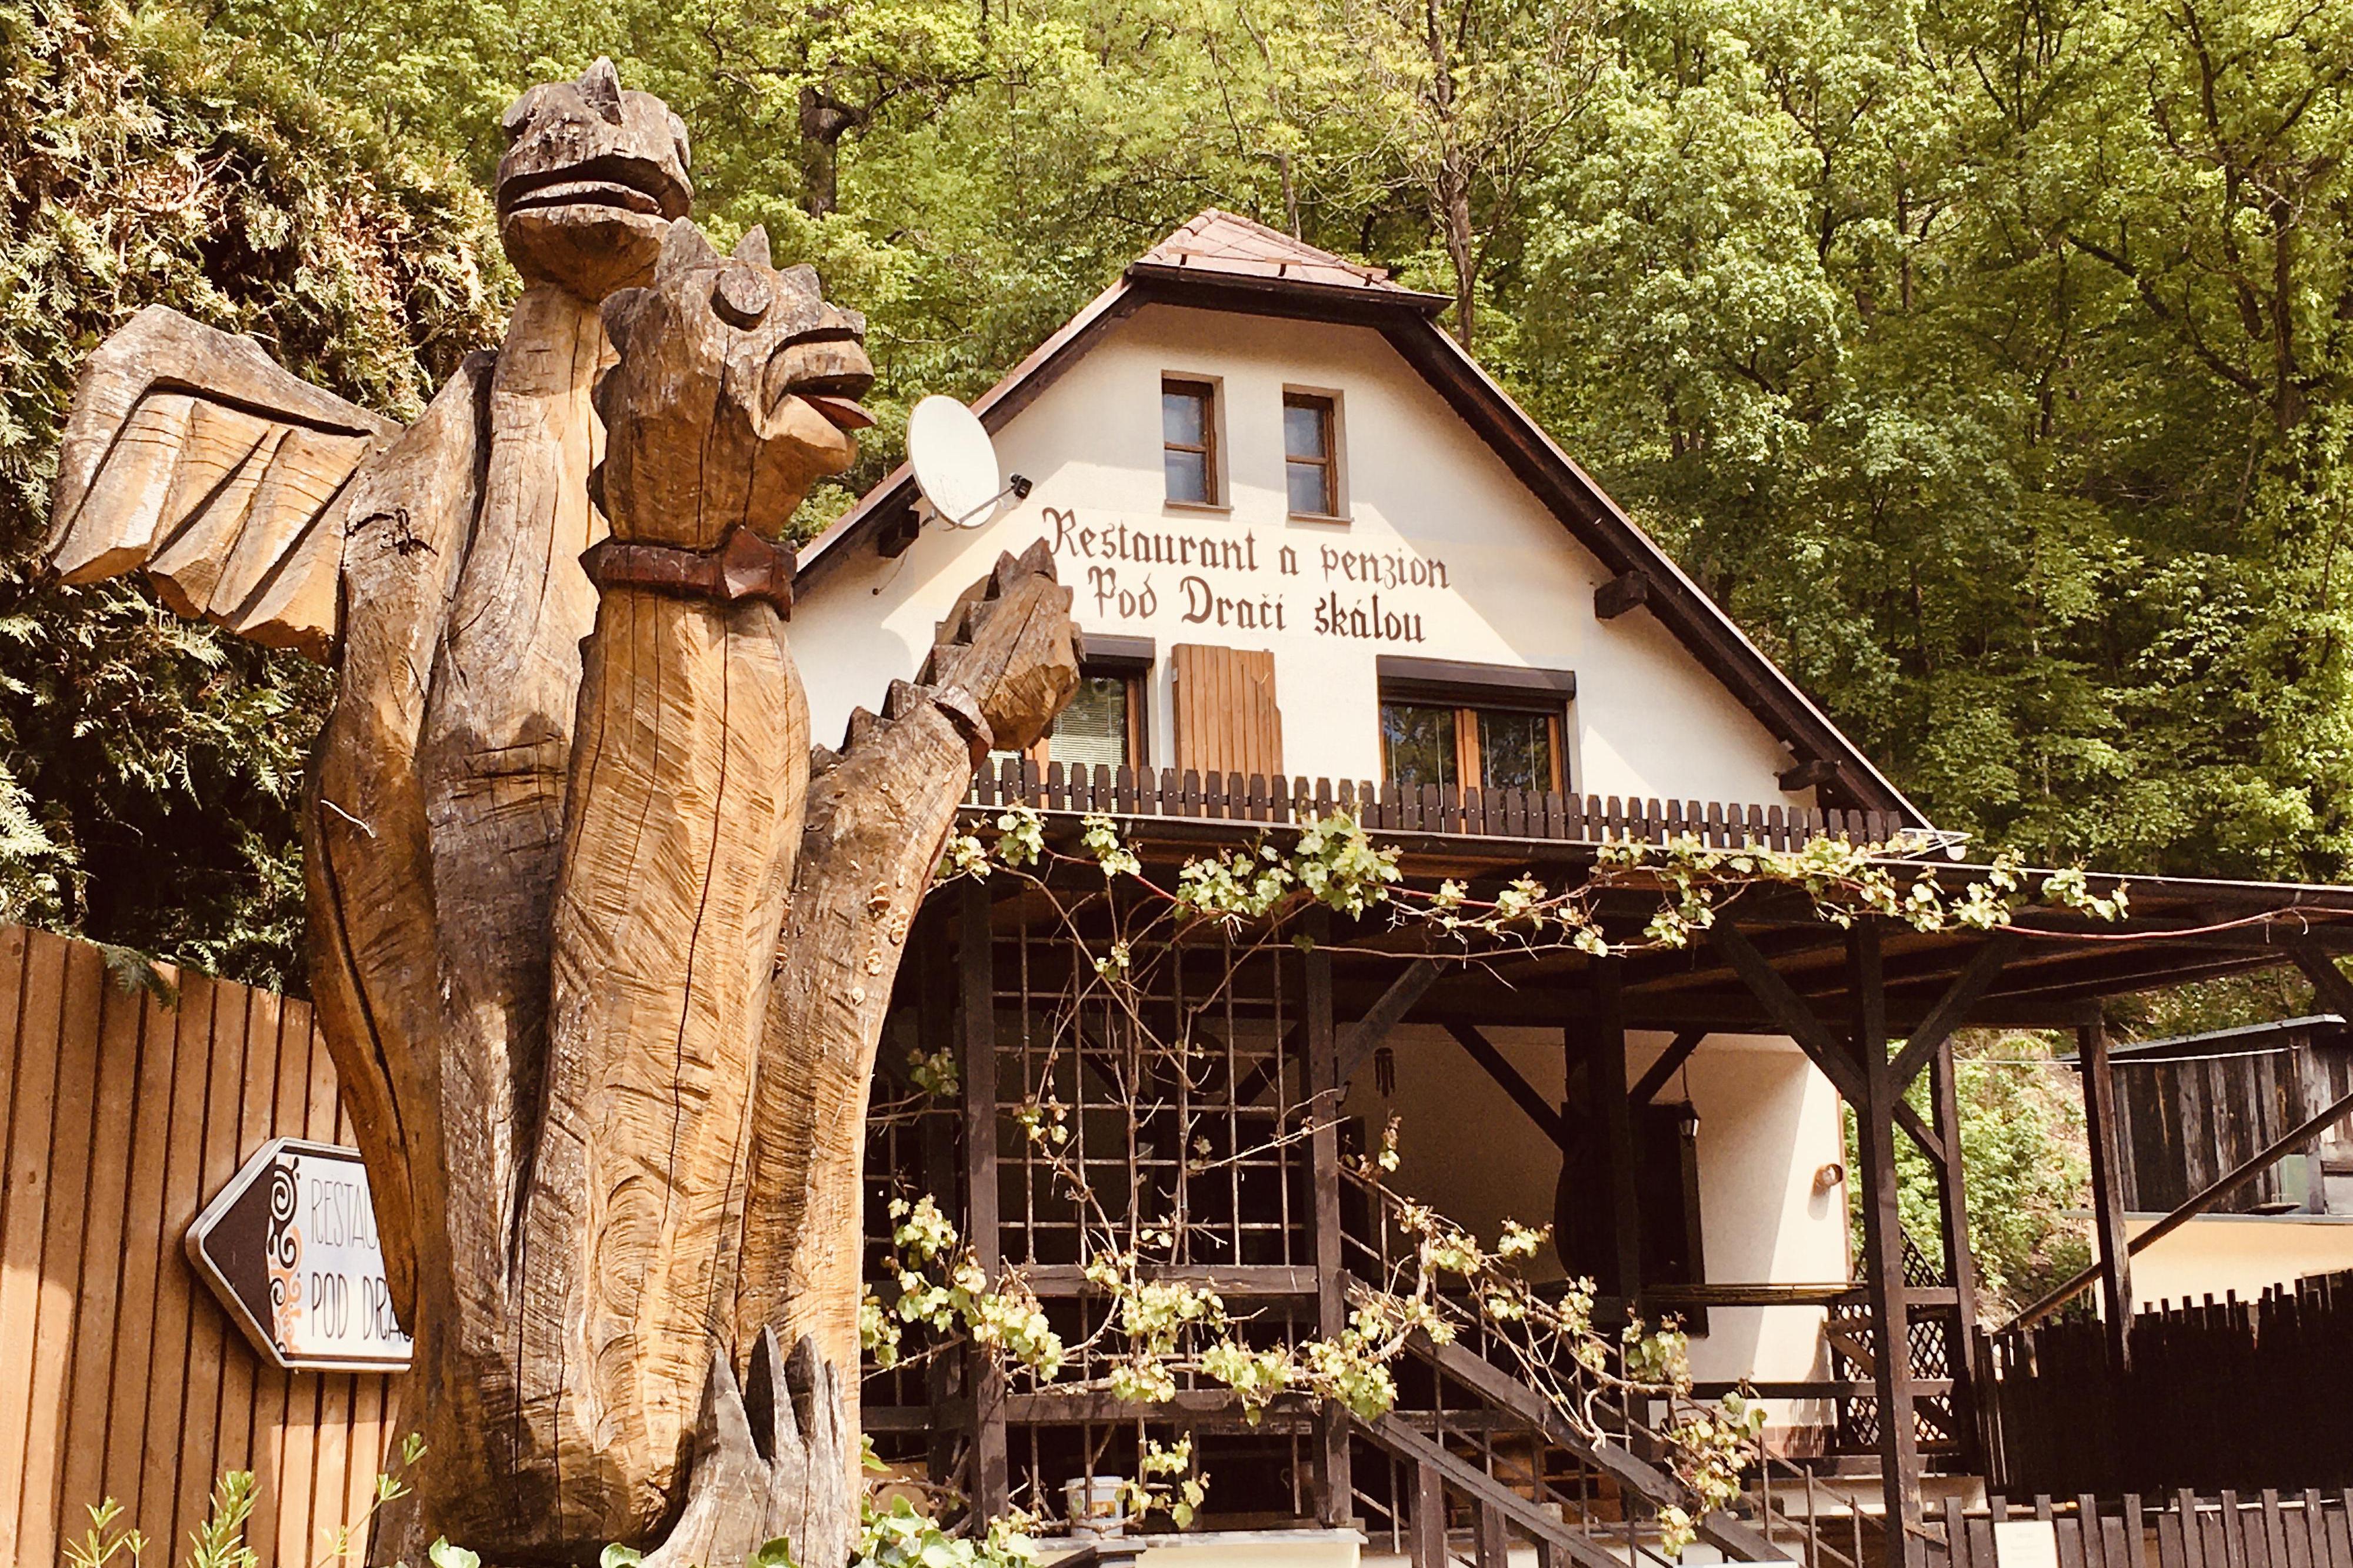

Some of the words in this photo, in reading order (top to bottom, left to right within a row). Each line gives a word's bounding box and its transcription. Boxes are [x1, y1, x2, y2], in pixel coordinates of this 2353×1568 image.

[1042, 506, 1259, 572] Restaurant
[1279, 544, 1300, 576] a
[1320, 543, 1450, 590] penzion
[1087, 565, 1158, 619] Pod
[1179, 575, 1287, 632] Dračí
[312, 1271, 349, 1339] POD
[362, 1275, 412, 1343] DRA
